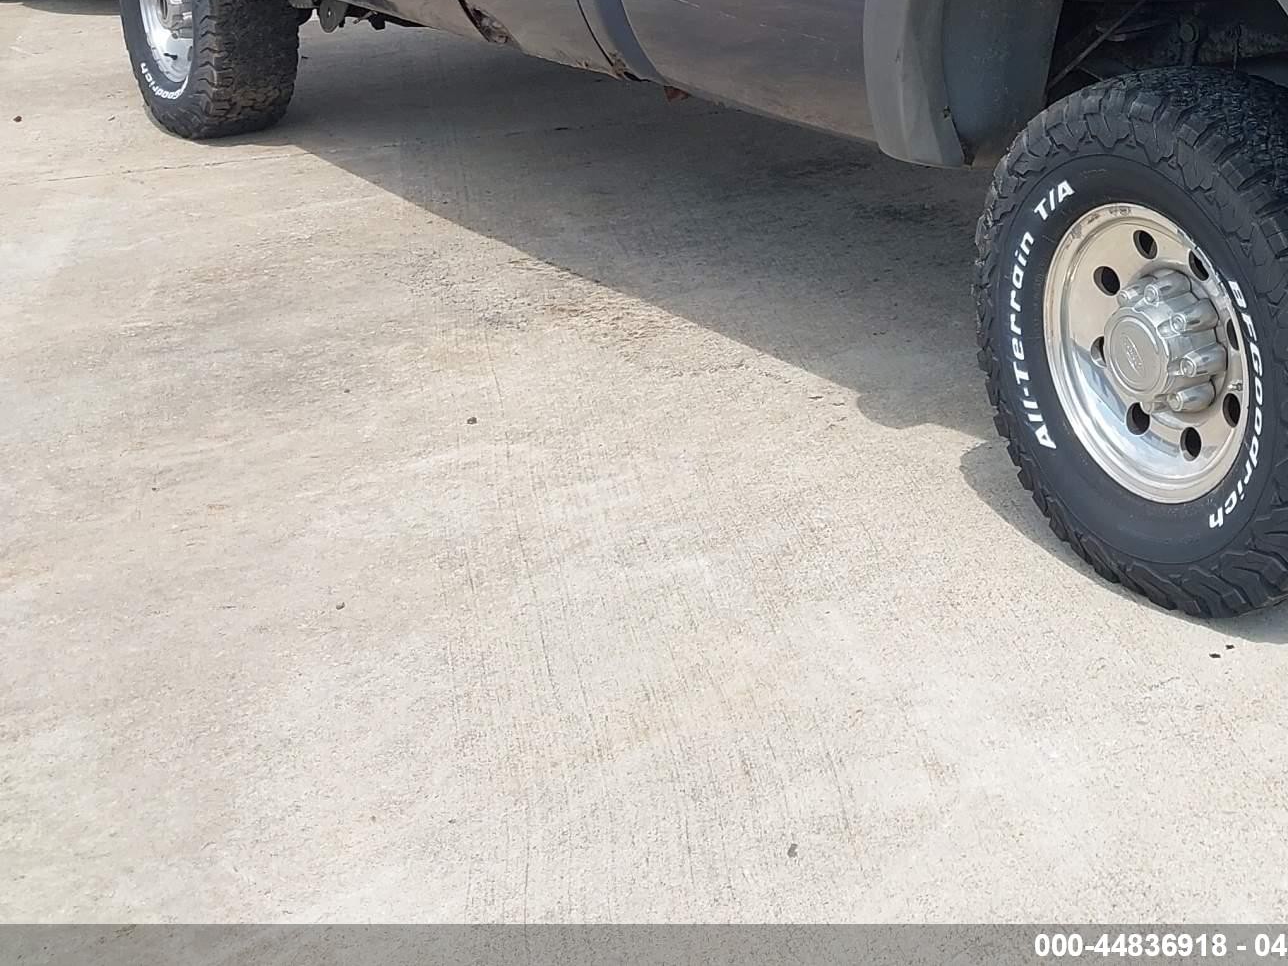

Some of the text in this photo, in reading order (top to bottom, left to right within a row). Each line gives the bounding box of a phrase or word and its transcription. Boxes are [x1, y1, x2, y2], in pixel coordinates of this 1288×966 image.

[1011, 179, 1076, 450] All-Terrain T/A
[1208, 280, 1264, 529] BFGoodrich
